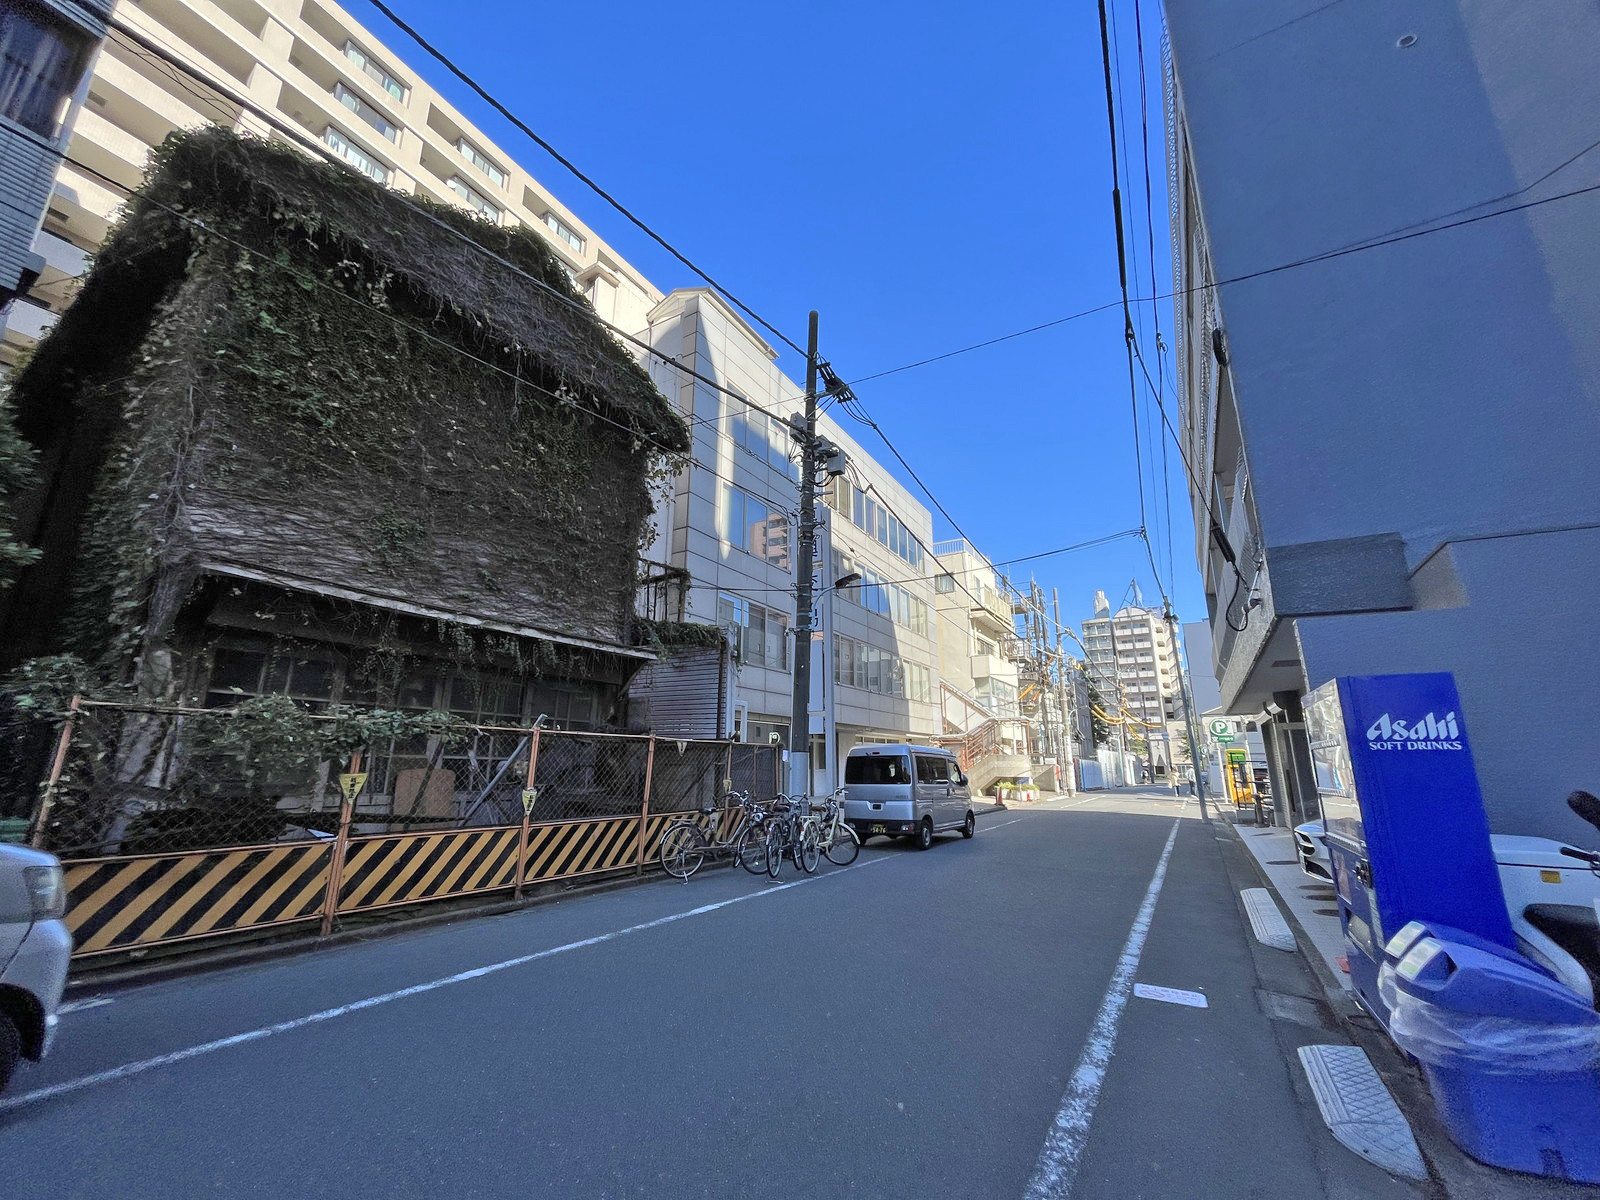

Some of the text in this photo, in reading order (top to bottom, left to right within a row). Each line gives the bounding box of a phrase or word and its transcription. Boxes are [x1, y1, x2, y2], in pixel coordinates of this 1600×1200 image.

[1215, 721, 1226, 733] P
[1366, 711, 1459, 740] Asahi
[1369, 741, 1462, 750] SOFT DRINKS
